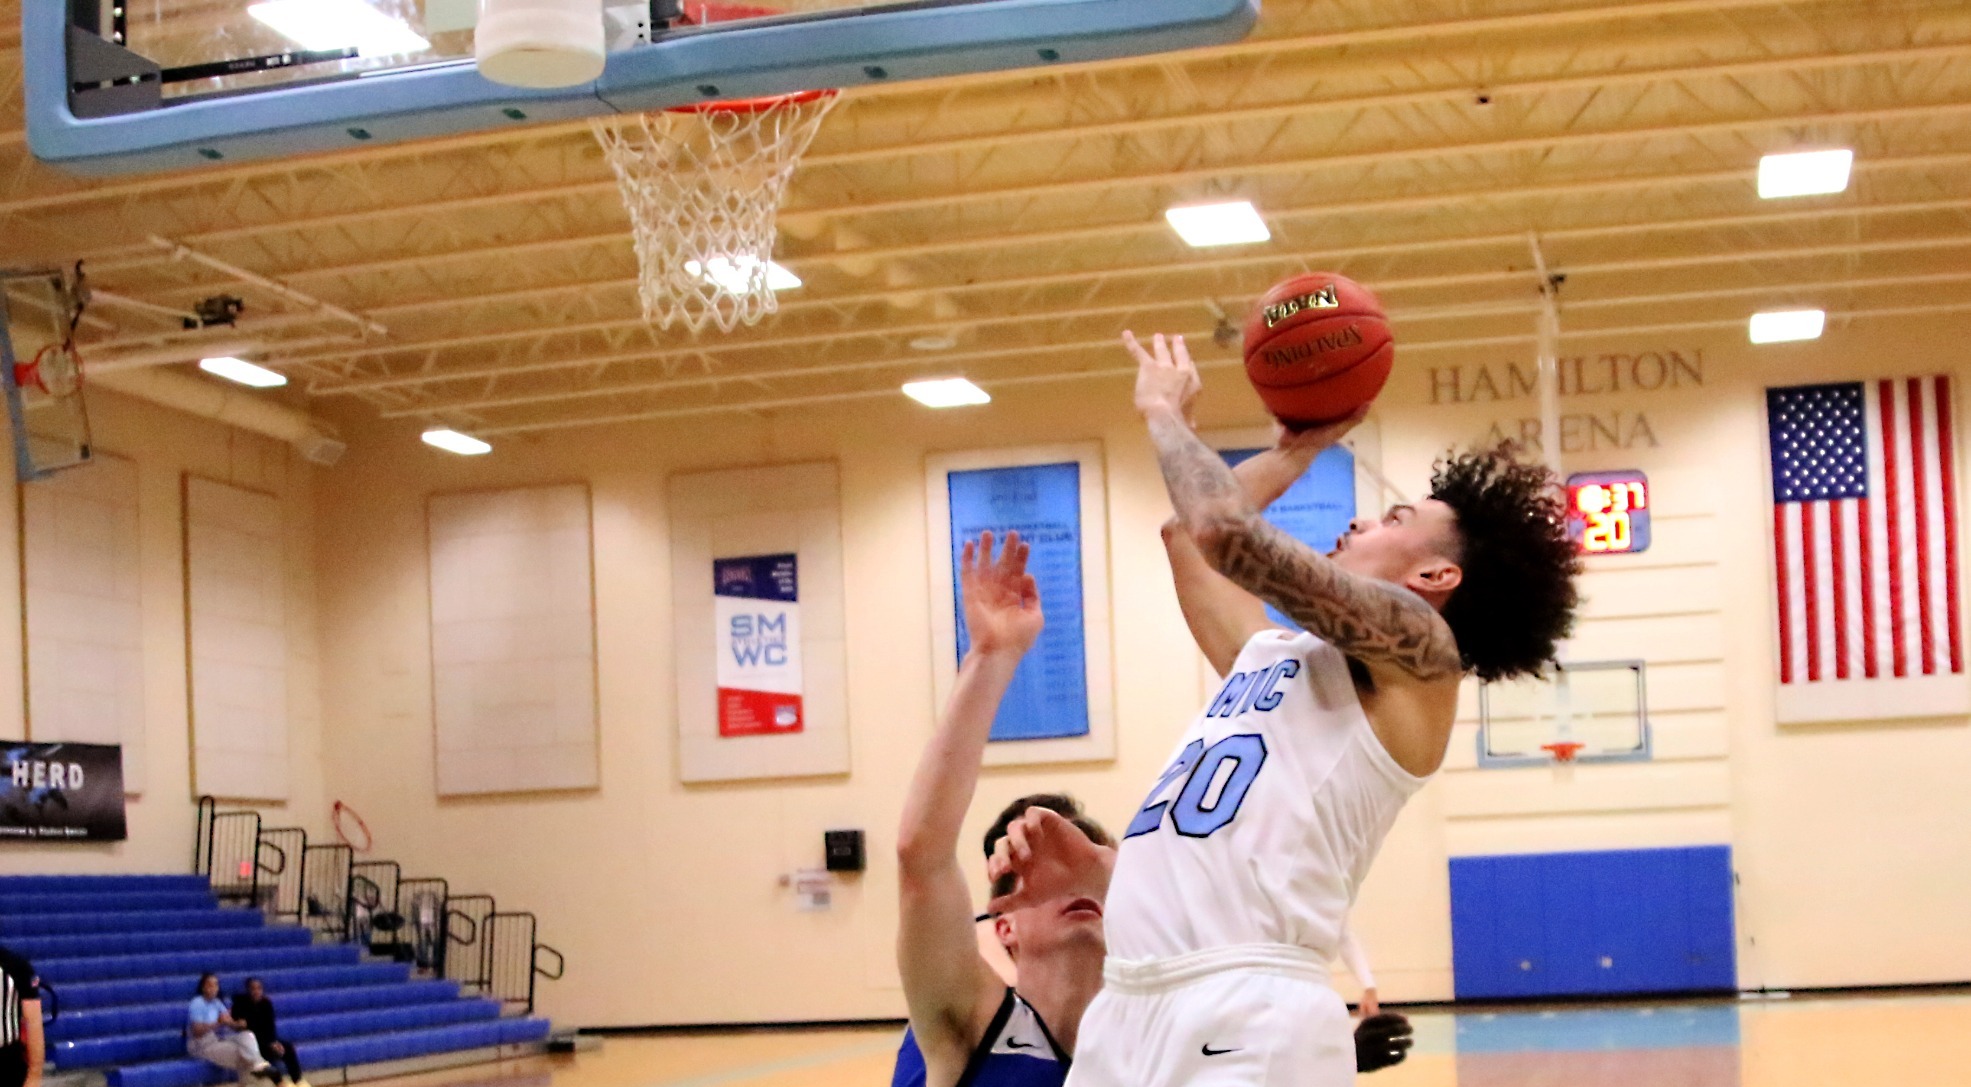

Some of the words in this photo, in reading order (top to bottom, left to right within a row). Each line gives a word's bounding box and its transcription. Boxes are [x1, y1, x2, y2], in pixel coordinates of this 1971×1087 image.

[1430, 349, 1705, 405] HAMILTON
[1483, 411, 1661, 453] ARENA
[1584, 513, 1631, 551] 20
[730, 612, 786, 638] SM
[731, 641, 788, 667] WC
[12, 760, 84, 790] HERD
[1123, 733, 1268, 839] 20
